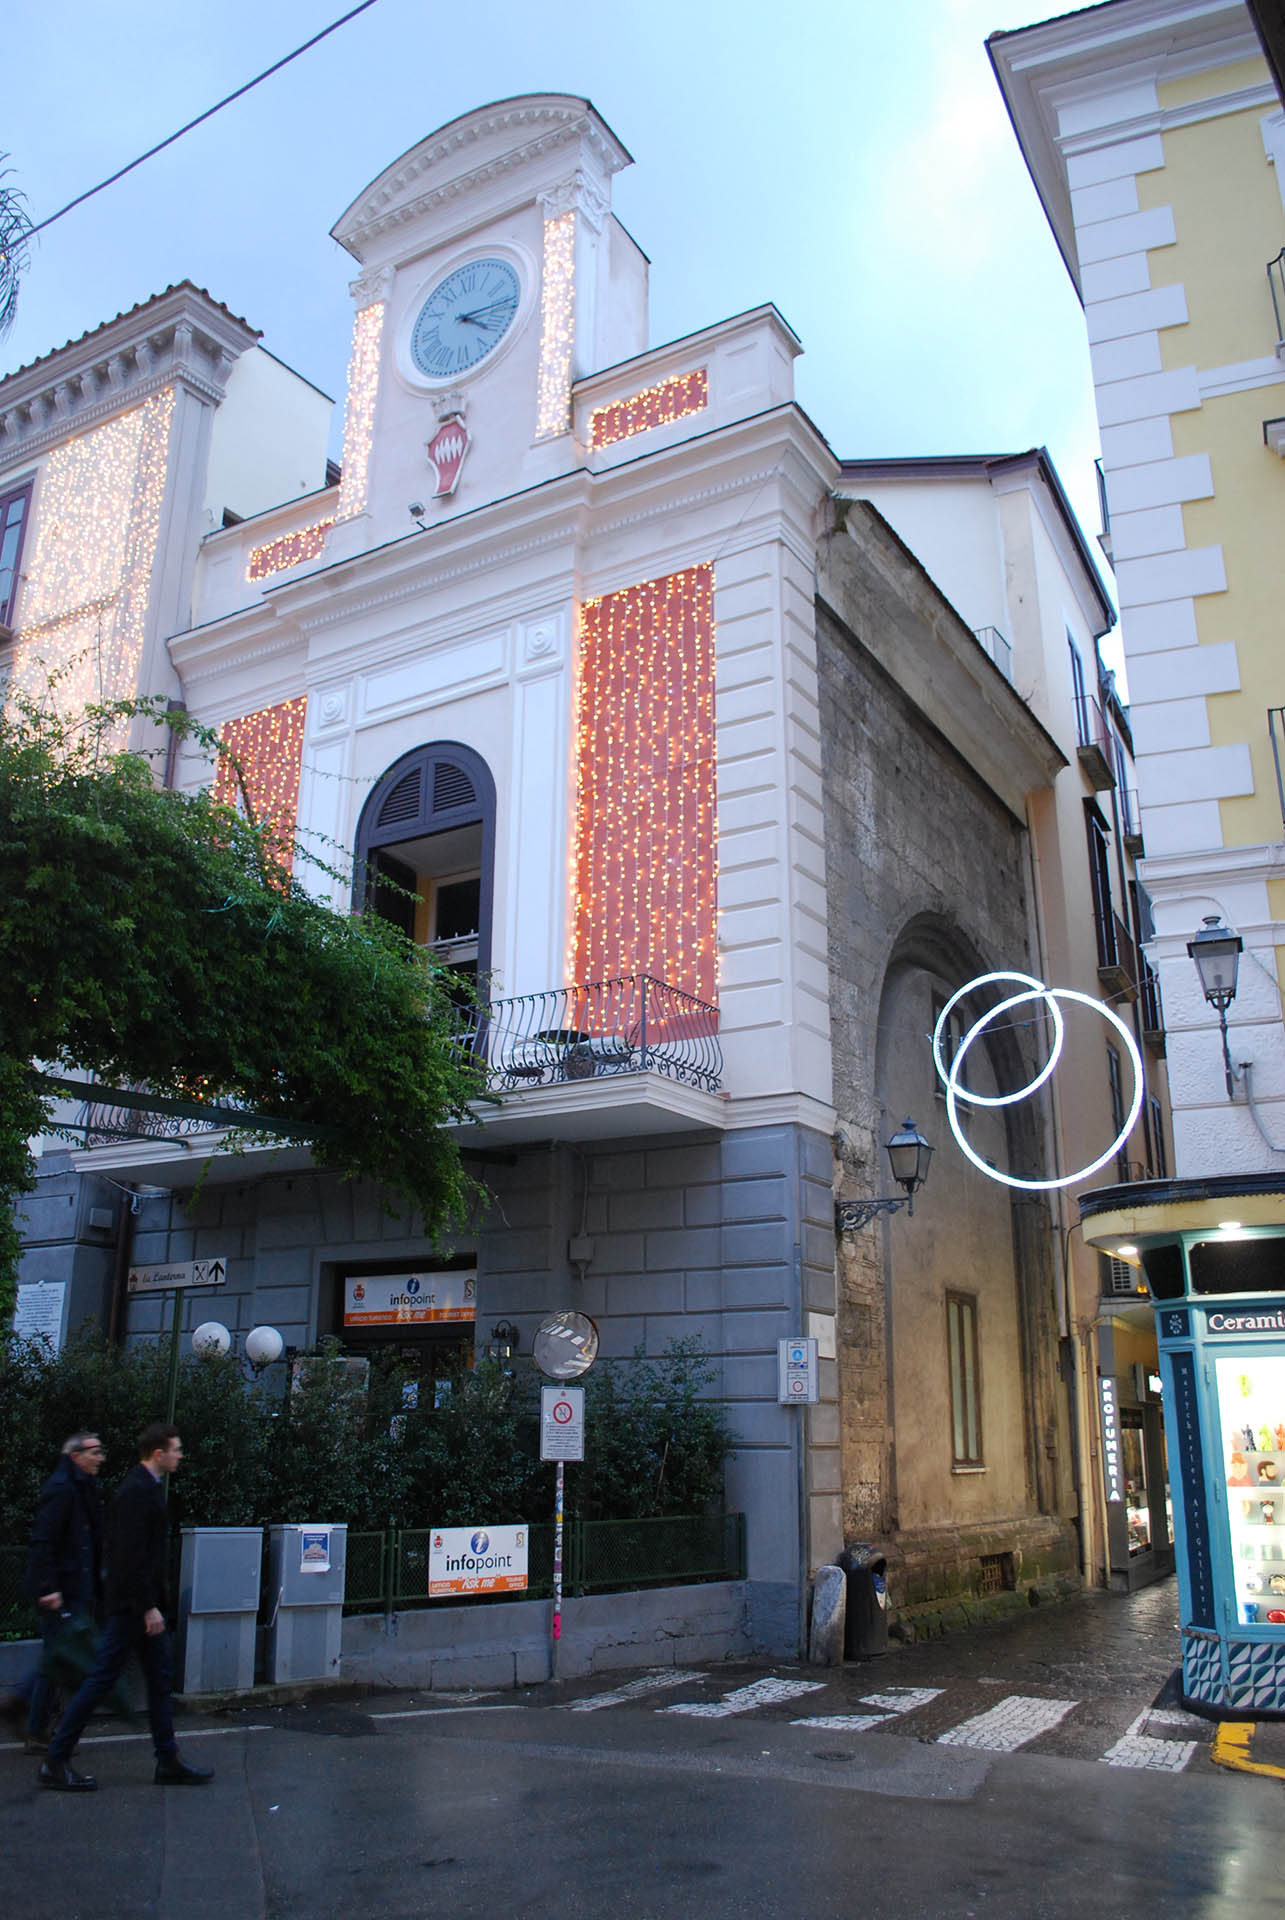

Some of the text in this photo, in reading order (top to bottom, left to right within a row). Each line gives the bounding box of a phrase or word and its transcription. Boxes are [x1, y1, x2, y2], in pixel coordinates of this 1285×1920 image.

[390, 1293, 436, 1307] infopoint
[1208, 1310, 1285, 1331] Cerami
[1101, 1378, 1121, 1502] PROFUMERIA
[446, 1553, 513, 1574] infopoint
